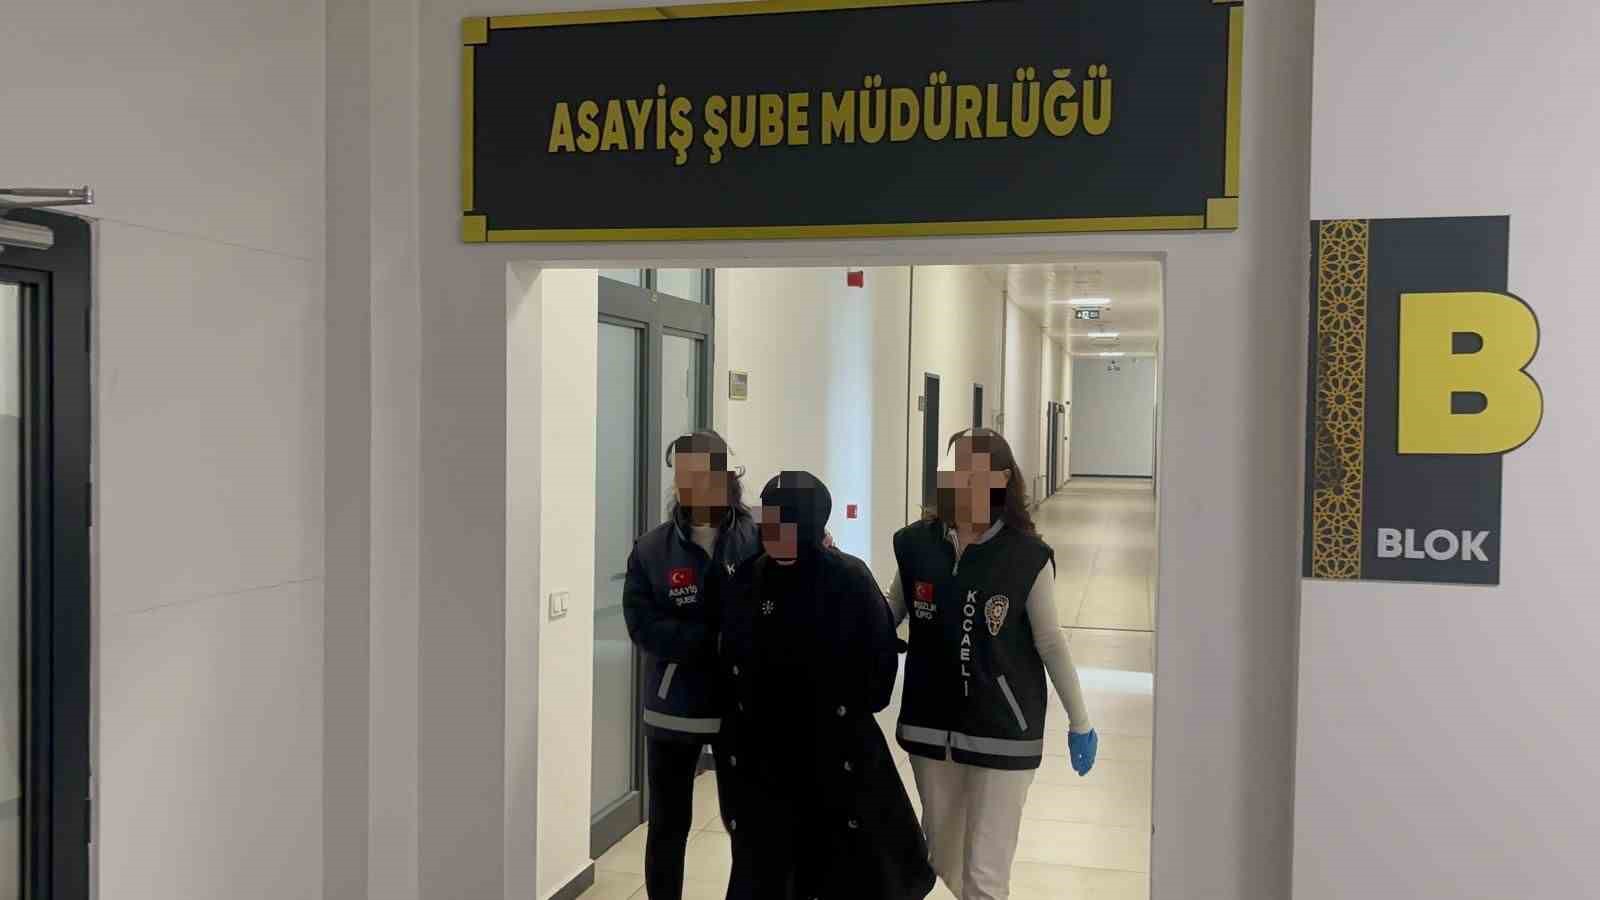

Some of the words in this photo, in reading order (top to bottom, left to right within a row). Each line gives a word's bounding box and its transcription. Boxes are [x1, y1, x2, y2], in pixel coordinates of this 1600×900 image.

[548, 84, 693, 164] ASAYİŞ
[704, 92, 810, 162] ŞUBE
[821, 64, 1113, 145] MÜDÜRLÜĞÜ
[1398, 291, 1543, 455] B
[1377, 527, 1490, 562] BLOK
